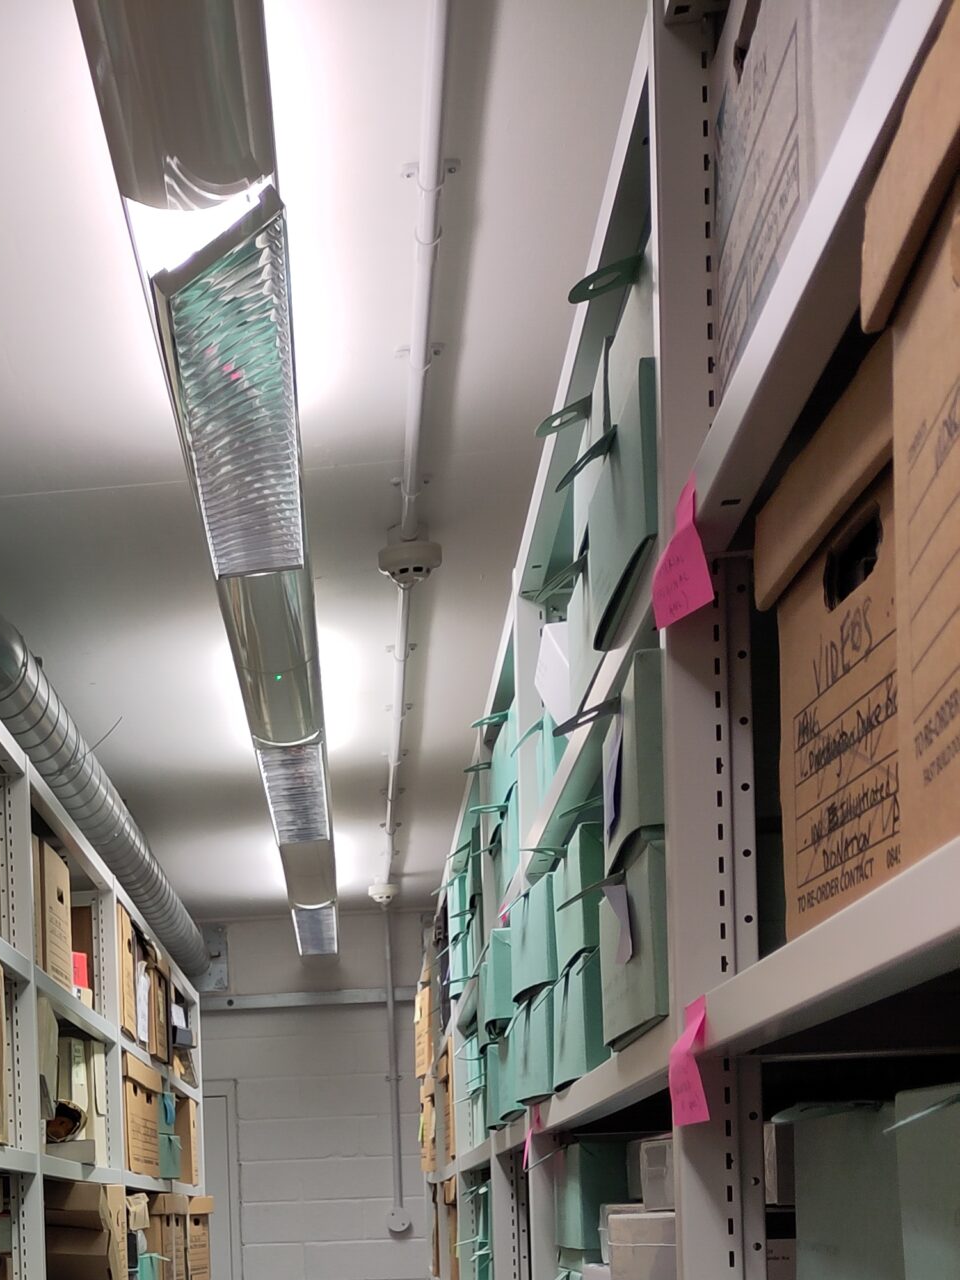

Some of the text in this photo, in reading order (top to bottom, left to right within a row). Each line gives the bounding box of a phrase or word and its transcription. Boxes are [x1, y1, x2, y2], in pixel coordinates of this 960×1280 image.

[797, 895, 807, 914] TO
[806, 877, 840, 908] RE-ORDER
[840, 856, 875, 893] CONTACT
